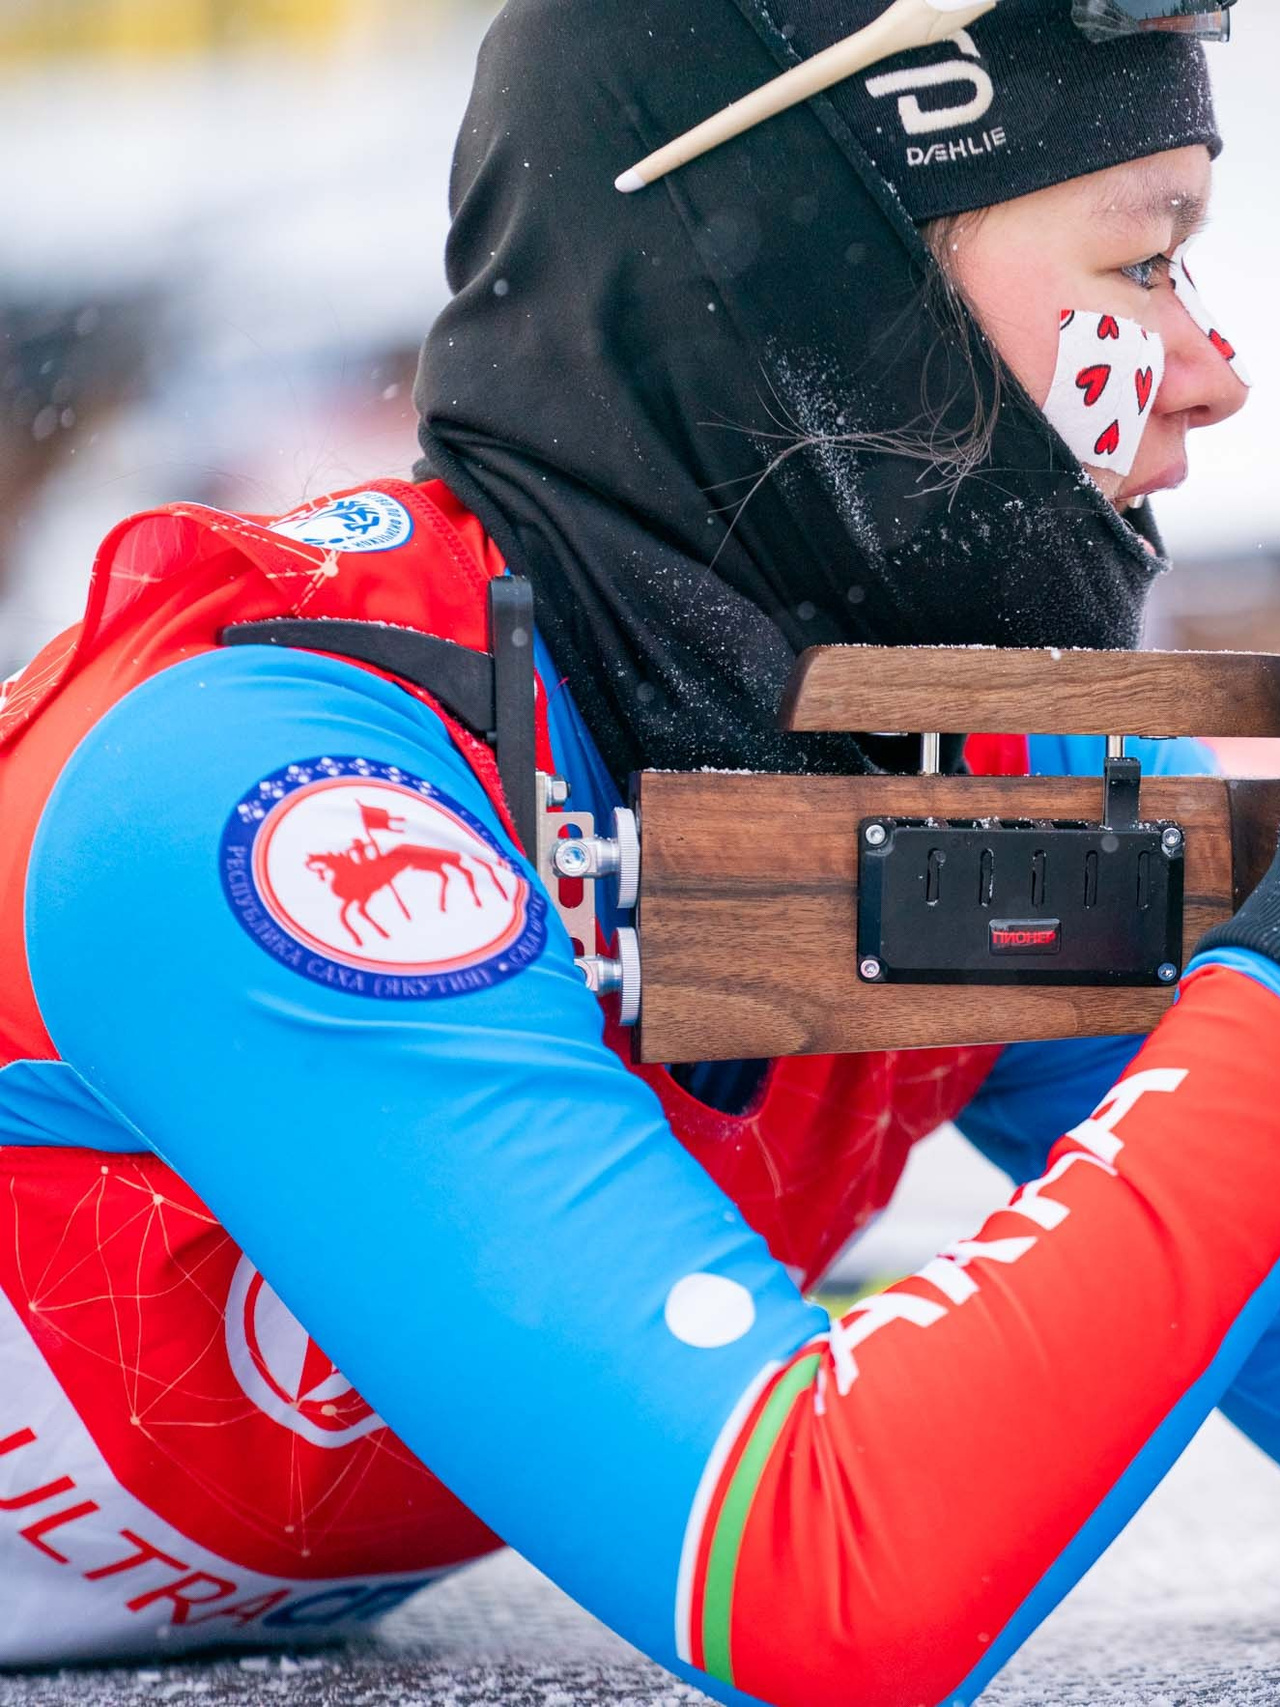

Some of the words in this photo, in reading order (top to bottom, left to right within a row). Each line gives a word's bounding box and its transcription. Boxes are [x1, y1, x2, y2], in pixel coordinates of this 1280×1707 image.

[227, 845, 300, 967] РЕСПУБЛИКА
[306, 958, 366, 993] САХА
[373, 966, 492, 998] (ЯКУТИЯ)
[992, 930, 1056, 945] ПИОНЕР
